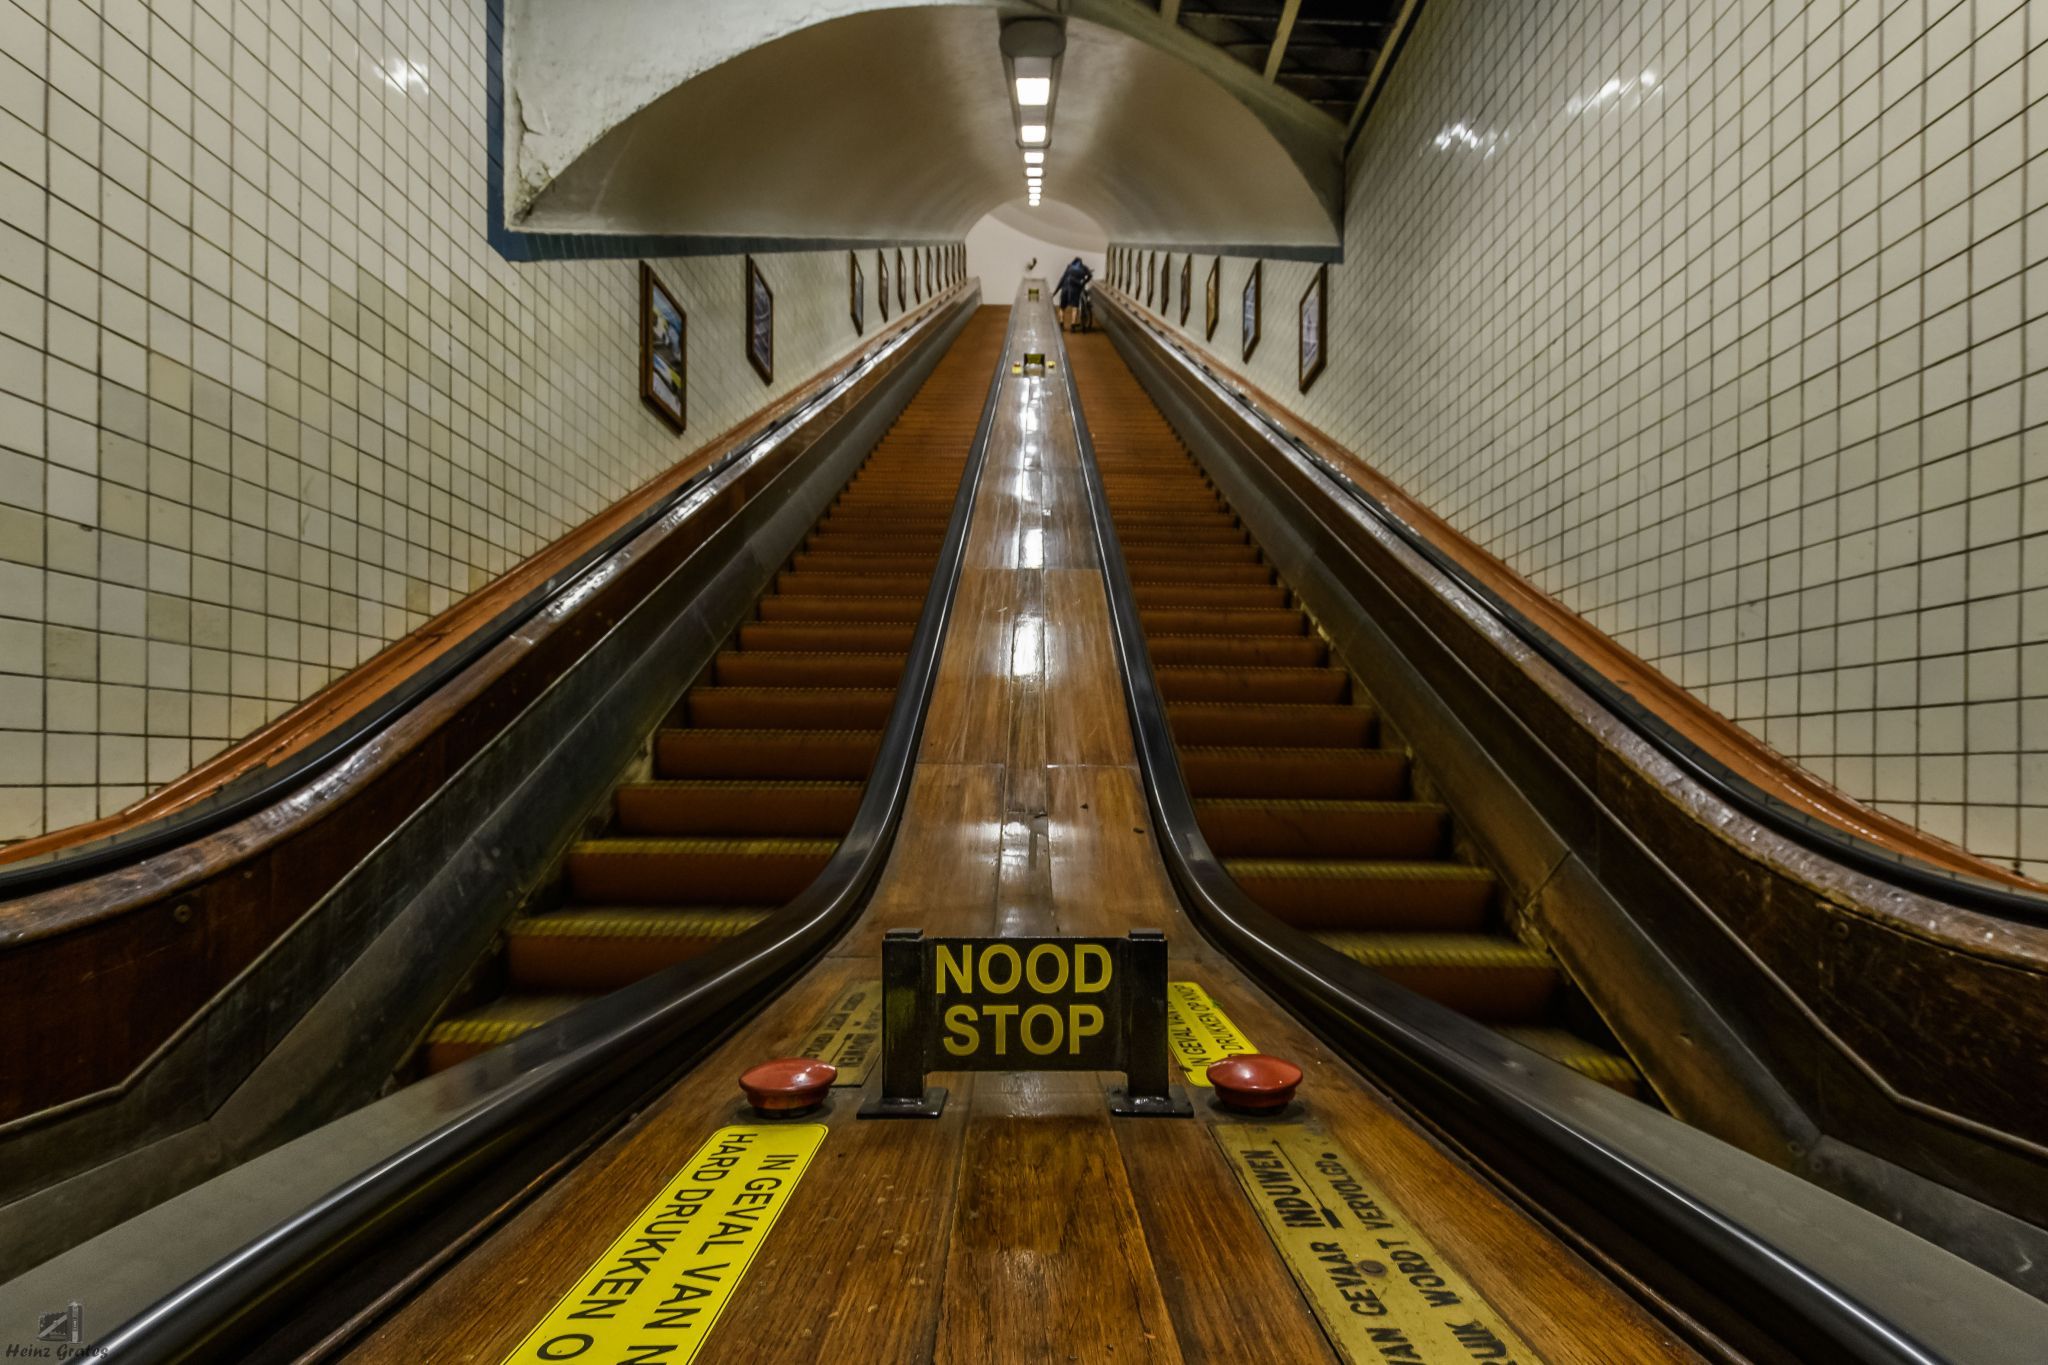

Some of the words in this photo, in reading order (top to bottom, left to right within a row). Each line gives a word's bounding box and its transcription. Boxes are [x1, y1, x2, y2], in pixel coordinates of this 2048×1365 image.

[936, 943, 1112, 994] NOOD
[943, 1003, 1104, 1057] STOP
[692, 1133, 758, 1182] HARD
[758, 1154, 799, 1171] IN
[1240, 1150, 1326, 1229] INDUWEN
[696, 1176, 782, 1255] GEVAL
[566, 1188, 715, 1320] DRUKKEN
[1310, 1242, 1388, 1316] GEVAAR
[1377, 1238, 1463, 1308] WORDT
[643, 1262, 731, 1330] VAN
[537, 1333, 594, 1361] O
